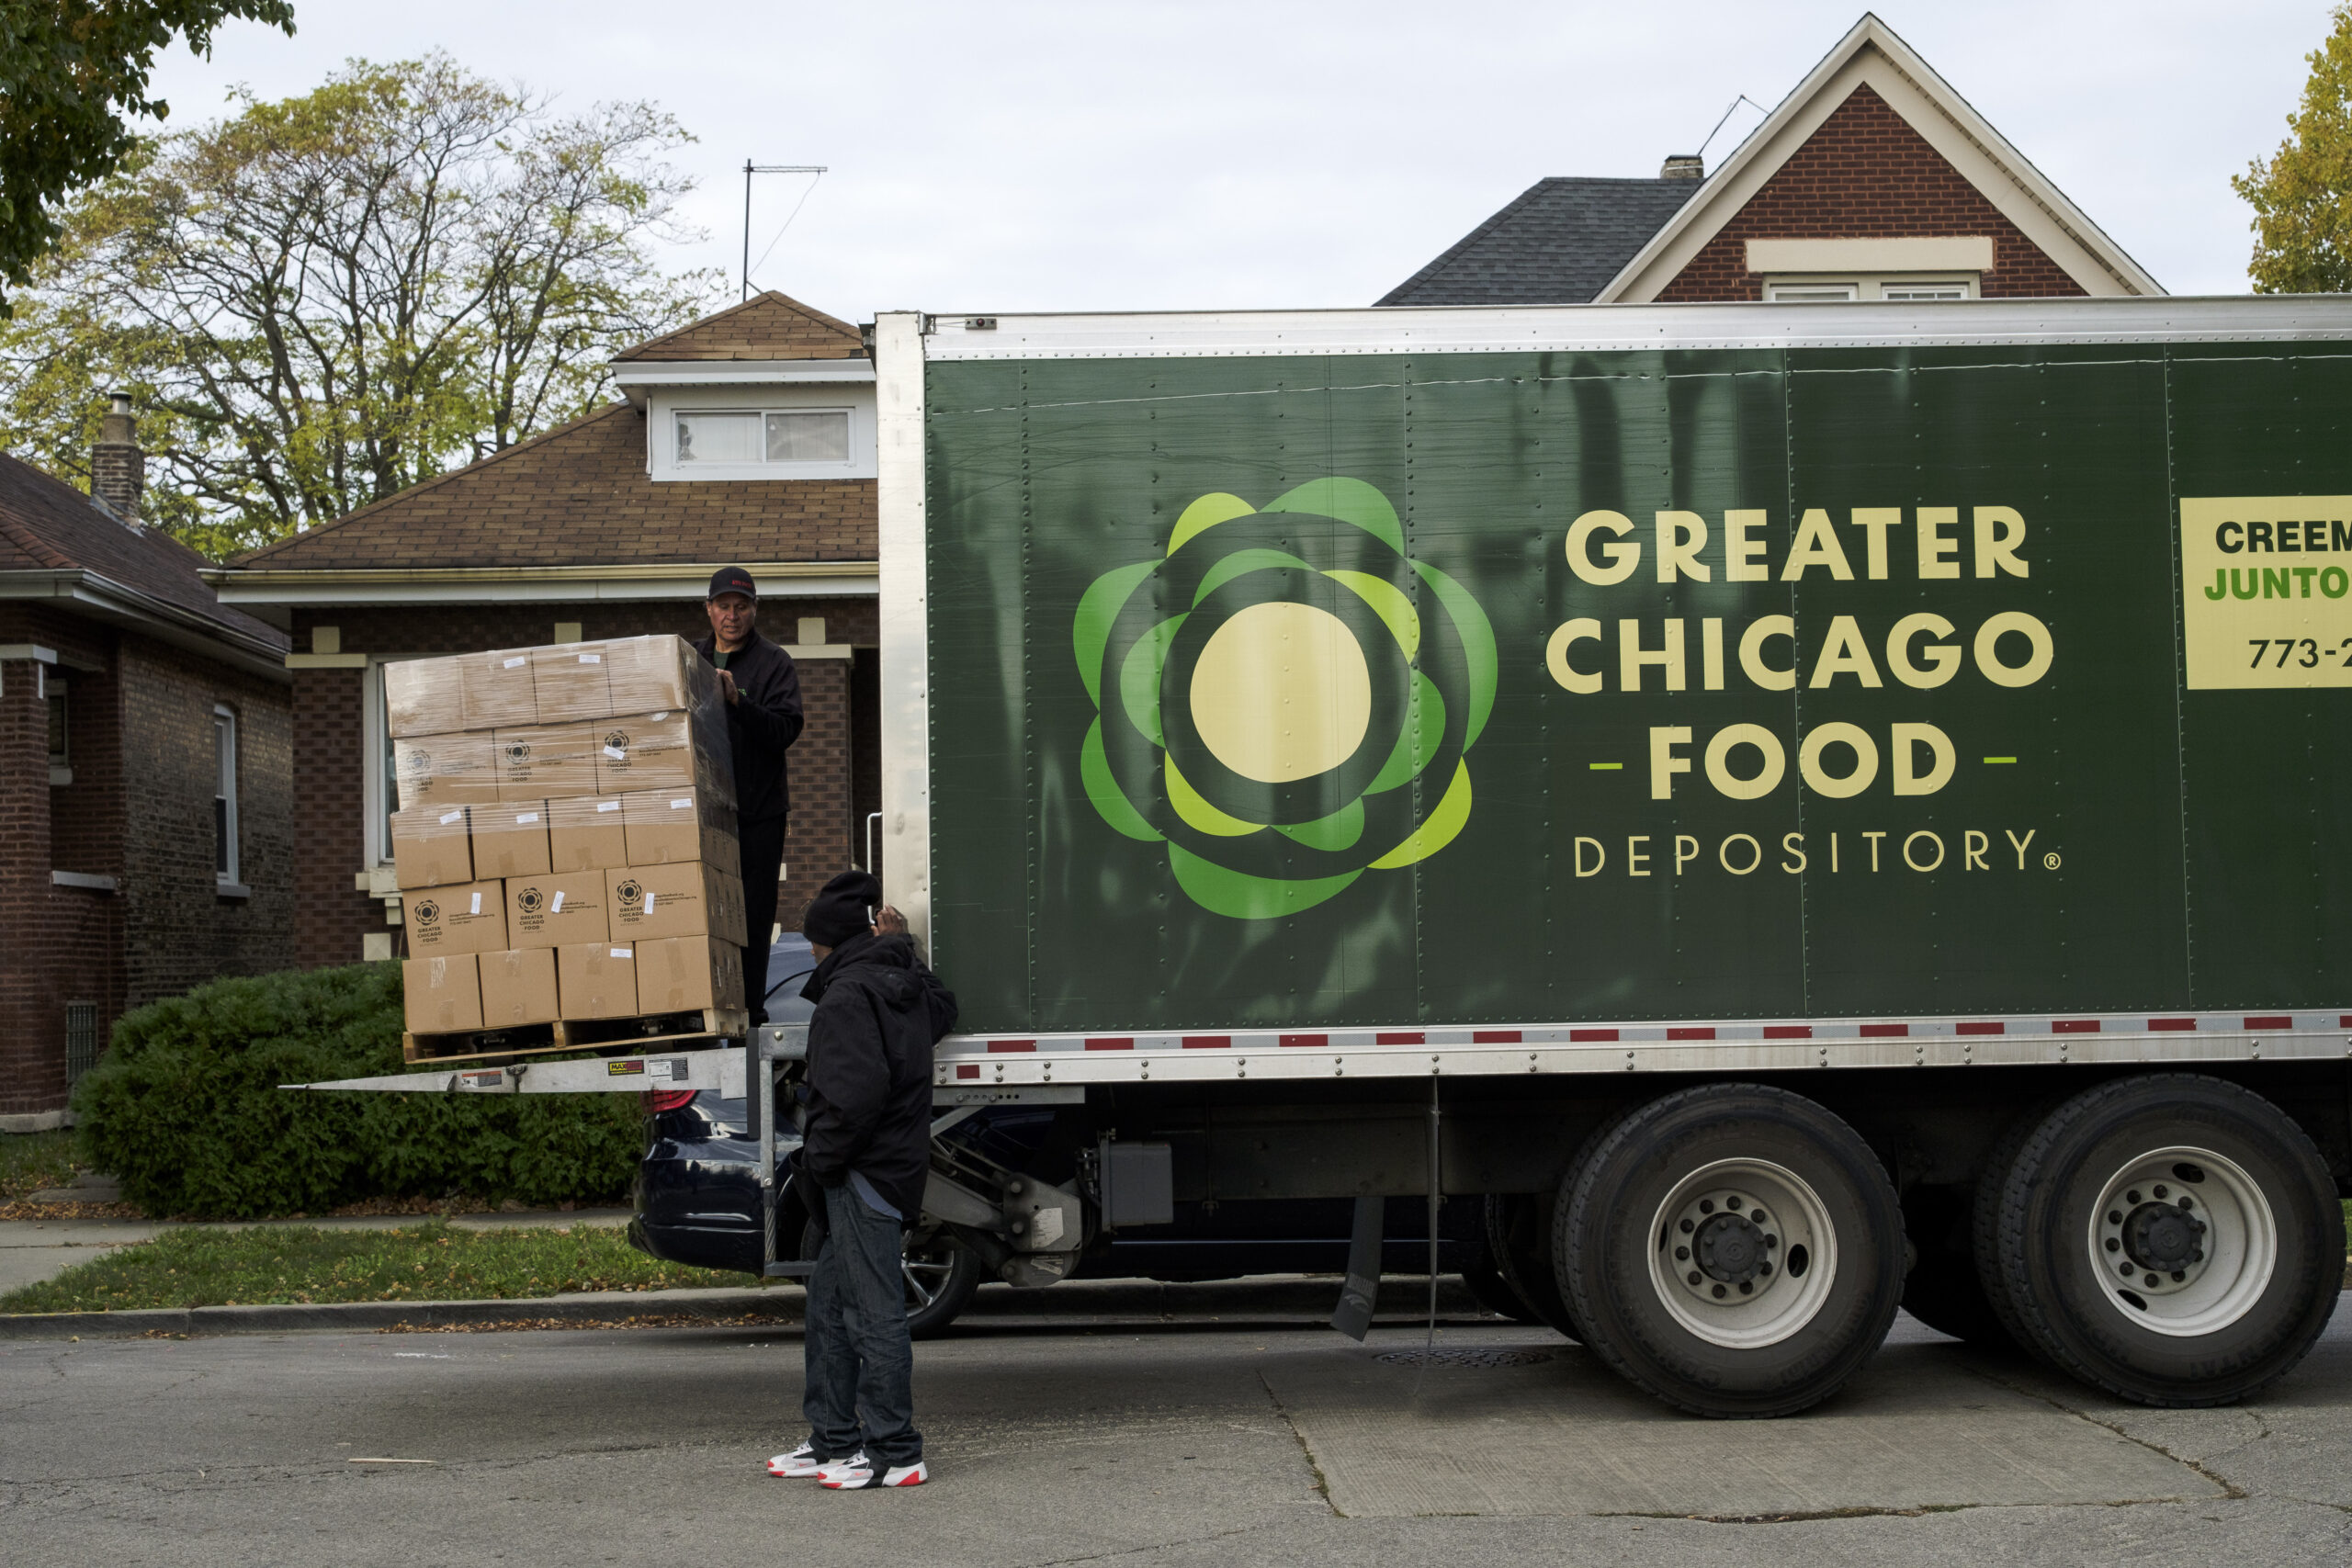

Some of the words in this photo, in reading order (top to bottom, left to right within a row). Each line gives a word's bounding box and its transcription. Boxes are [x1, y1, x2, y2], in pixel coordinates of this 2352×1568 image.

[1565, 505, 2030, 586] GREATER
[2215, 520, 2352, 554] CREEM
[2204, 566, 2352, 601] JUNTO
[1545, 611, 2054, 694] CHICAGO
[1649, 721, 1957, 800] FOOD
